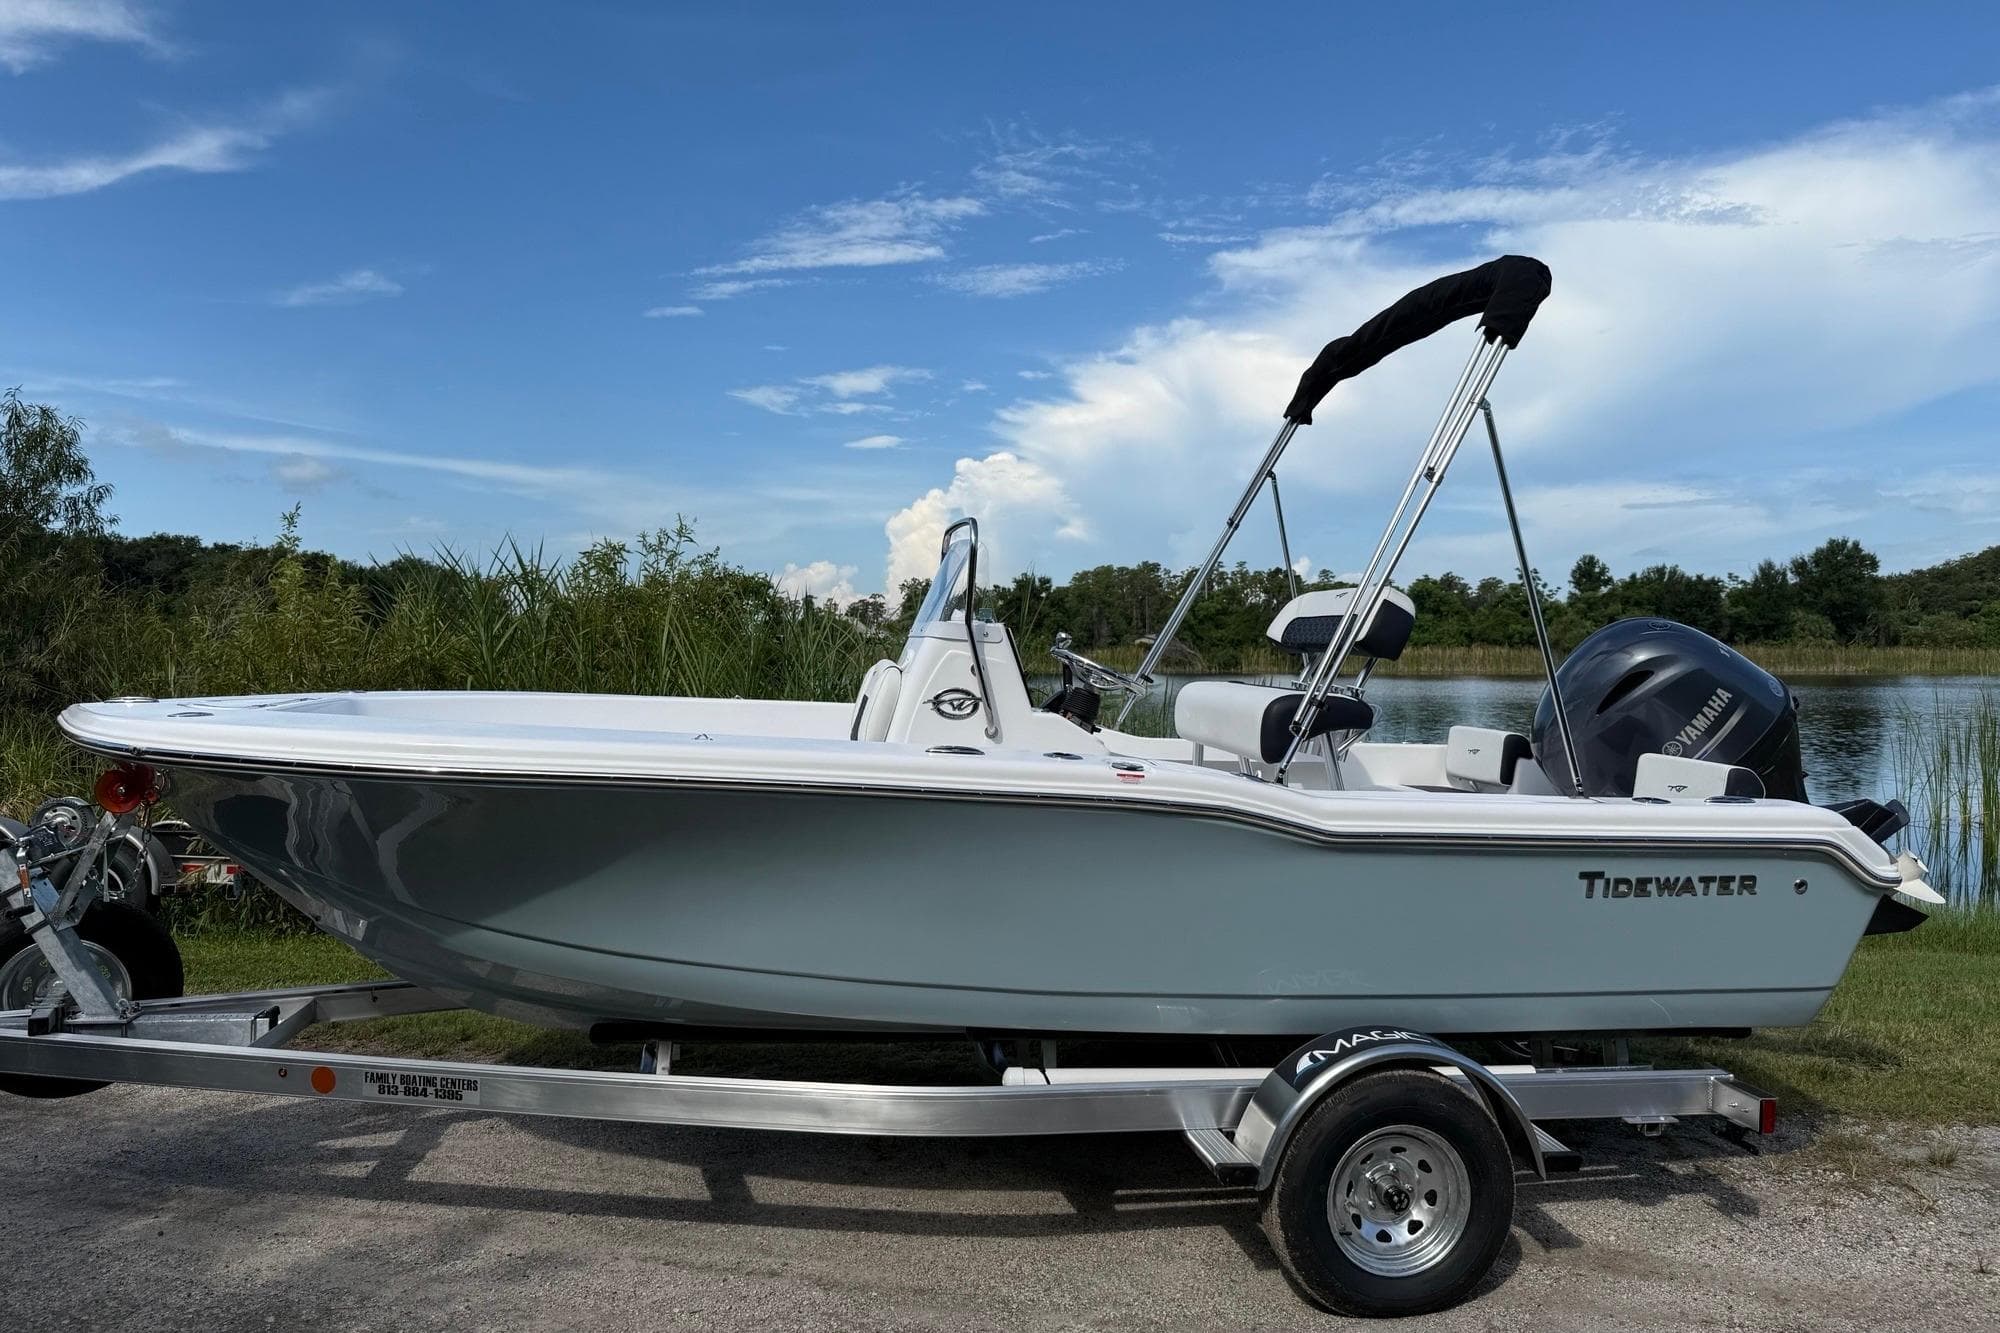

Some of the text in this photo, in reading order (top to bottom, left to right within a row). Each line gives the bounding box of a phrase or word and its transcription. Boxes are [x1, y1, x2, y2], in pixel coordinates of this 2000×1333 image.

[1675, 687, 1733, 745] YAMAHA
[1579, 871, 1757, 898] TIDEWATER
[1316, 1030, 1431, 1060] MAGIC
[364, 1071, 479, 1092] FAMILY BOATING CENTERS
